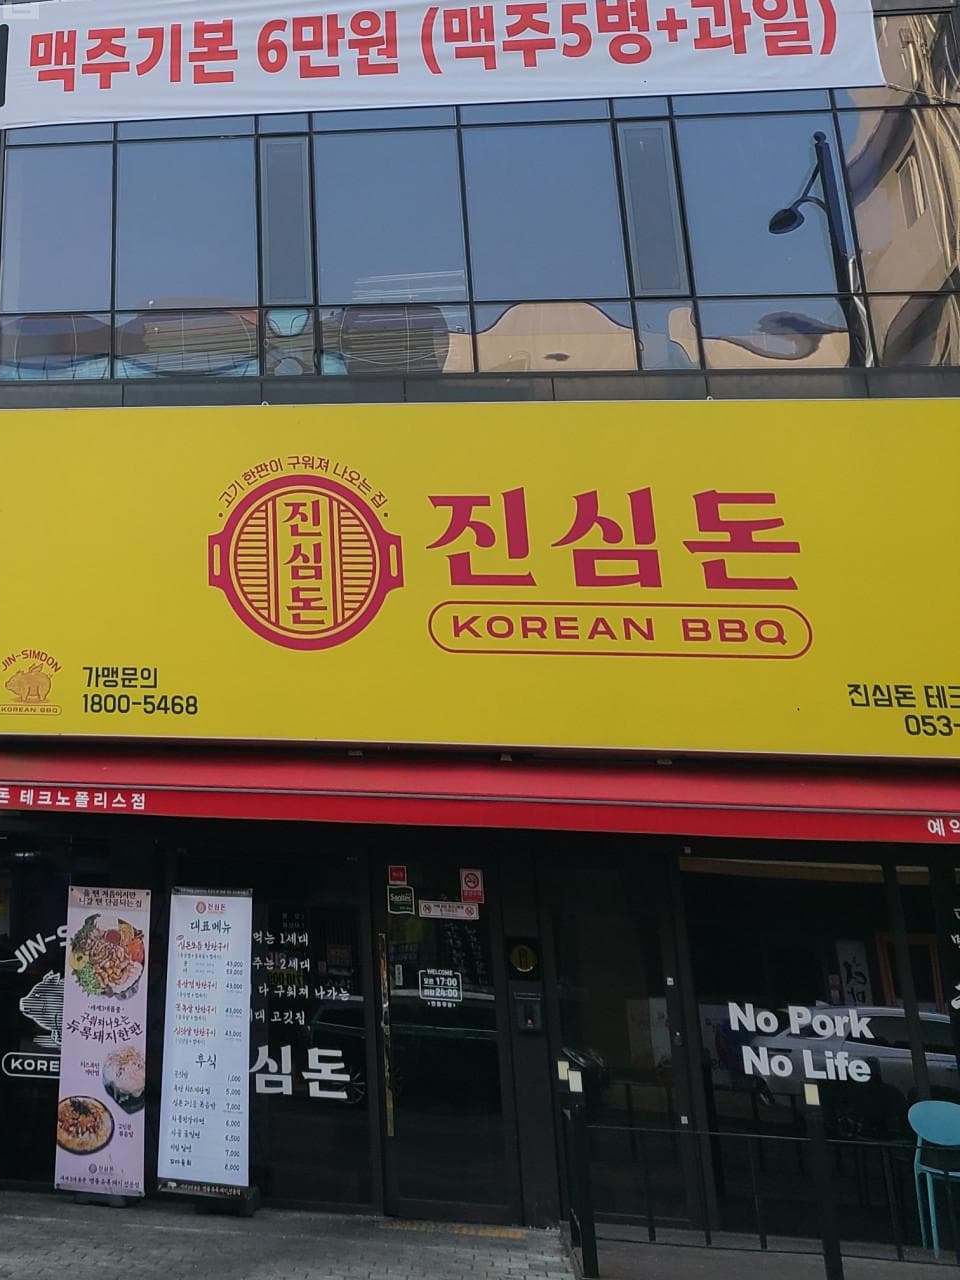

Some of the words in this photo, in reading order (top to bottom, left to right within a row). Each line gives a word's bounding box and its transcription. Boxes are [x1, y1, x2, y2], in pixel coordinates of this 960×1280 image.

[28, 18, 239, 92] 맥주기본
[256, 8, 399, 78] 6만원
[218, 479, 245, 508] 고기
[241, 457, 284, 486] 한판이
[287, 455, 330, 473] 구워져
[333, 462, 373, 496] 나오는
[370, 490, 388, 509] 집
[426, 486, 801, 591] 진심돈
[282, 499, 328, 625] 진심돈
[452, 614, 655, 642] KOREAN
[682, 618, 788, 646] BBQ
[1, 649, 62, 673] JIN-SIMDON
[82, 666, 158, 689] 가맹문의
[82, 694, 198, 715] 1800-5468
[847, 683, 916, 708] 진심돈
[19, 788, 145, 810] 테크노폴리스점
[189, 919, 232, 934] 대표메뉴
[279, 931, 309, 947] 1세대
[279, 958, 311, 973] 2세대
[426, 968, 453, 976] WELCOME
[435, 977, 458, 986] 17:00
[435, 988, 458, 997] 24:00
[314, 987, 351, 1001] 나가는
[250, 1007, 266, 1024] 대
[270, 1009, 306, 1025] 고깃집
[728, 1002, 778, 1035] No
[787, 1005, 874, 1040] Pork
[195, 1053, 217, 1069] 후식
[742, 1045, 792, 1078] No
[804, 1049, 872, 1083] Life
